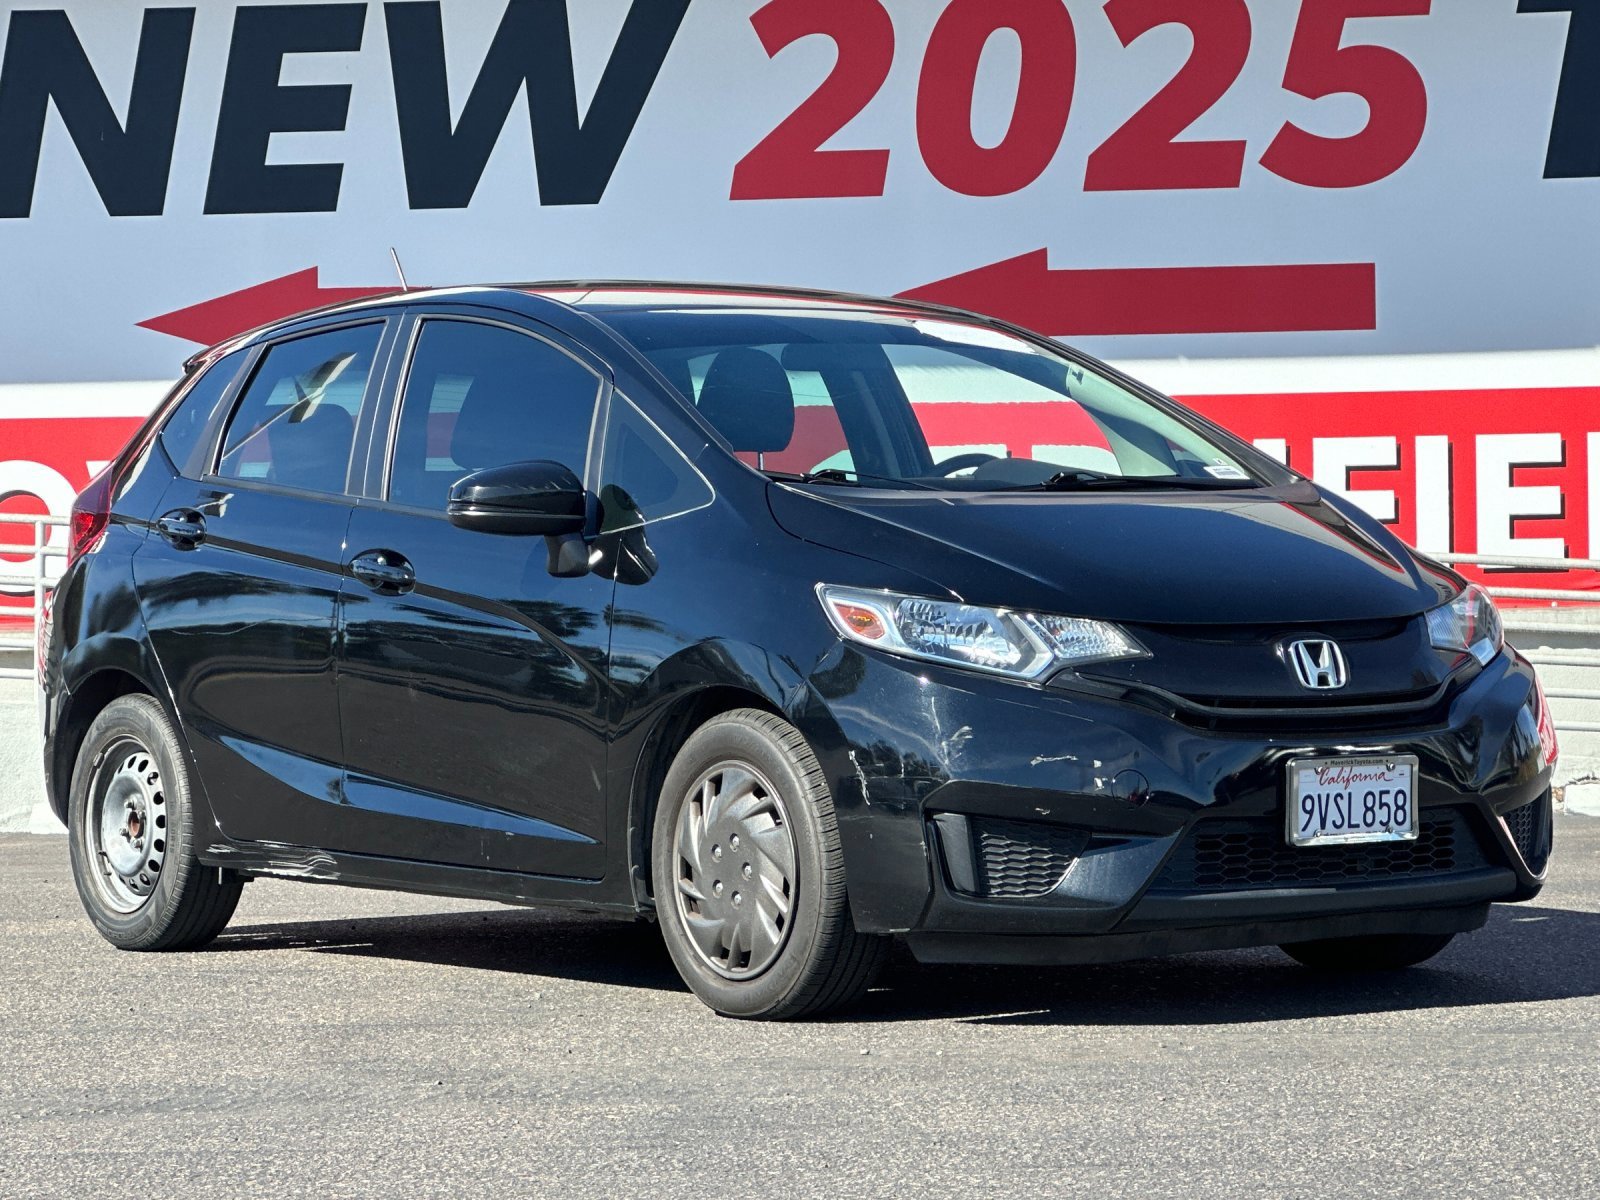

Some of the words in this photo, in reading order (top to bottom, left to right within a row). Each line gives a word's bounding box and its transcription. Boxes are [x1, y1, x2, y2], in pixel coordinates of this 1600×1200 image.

[0, 0, 690, 218] NEW
[729, 0, 1431, 200] 2025
[1318, 766, 1394, 790] California
[1301, 789, 1408, 832] 9VSL858
